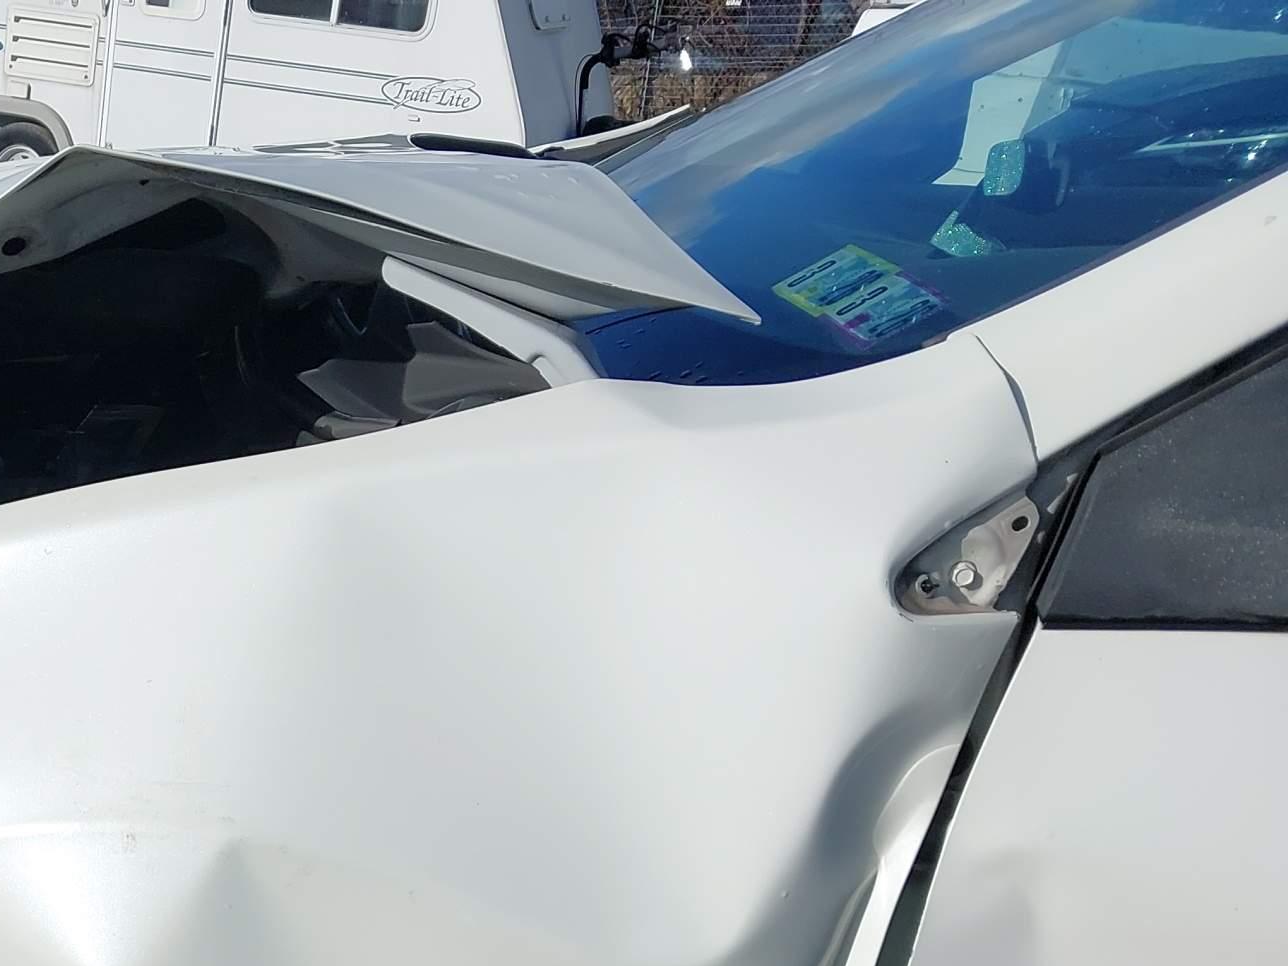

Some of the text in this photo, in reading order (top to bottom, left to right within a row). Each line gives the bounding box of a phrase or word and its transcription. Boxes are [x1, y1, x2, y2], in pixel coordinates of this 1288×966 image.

[393, 81, 471, 109] Trail-Lite
[787, 259, 837, 288] 3
[835, 286, 888, 317] 3
